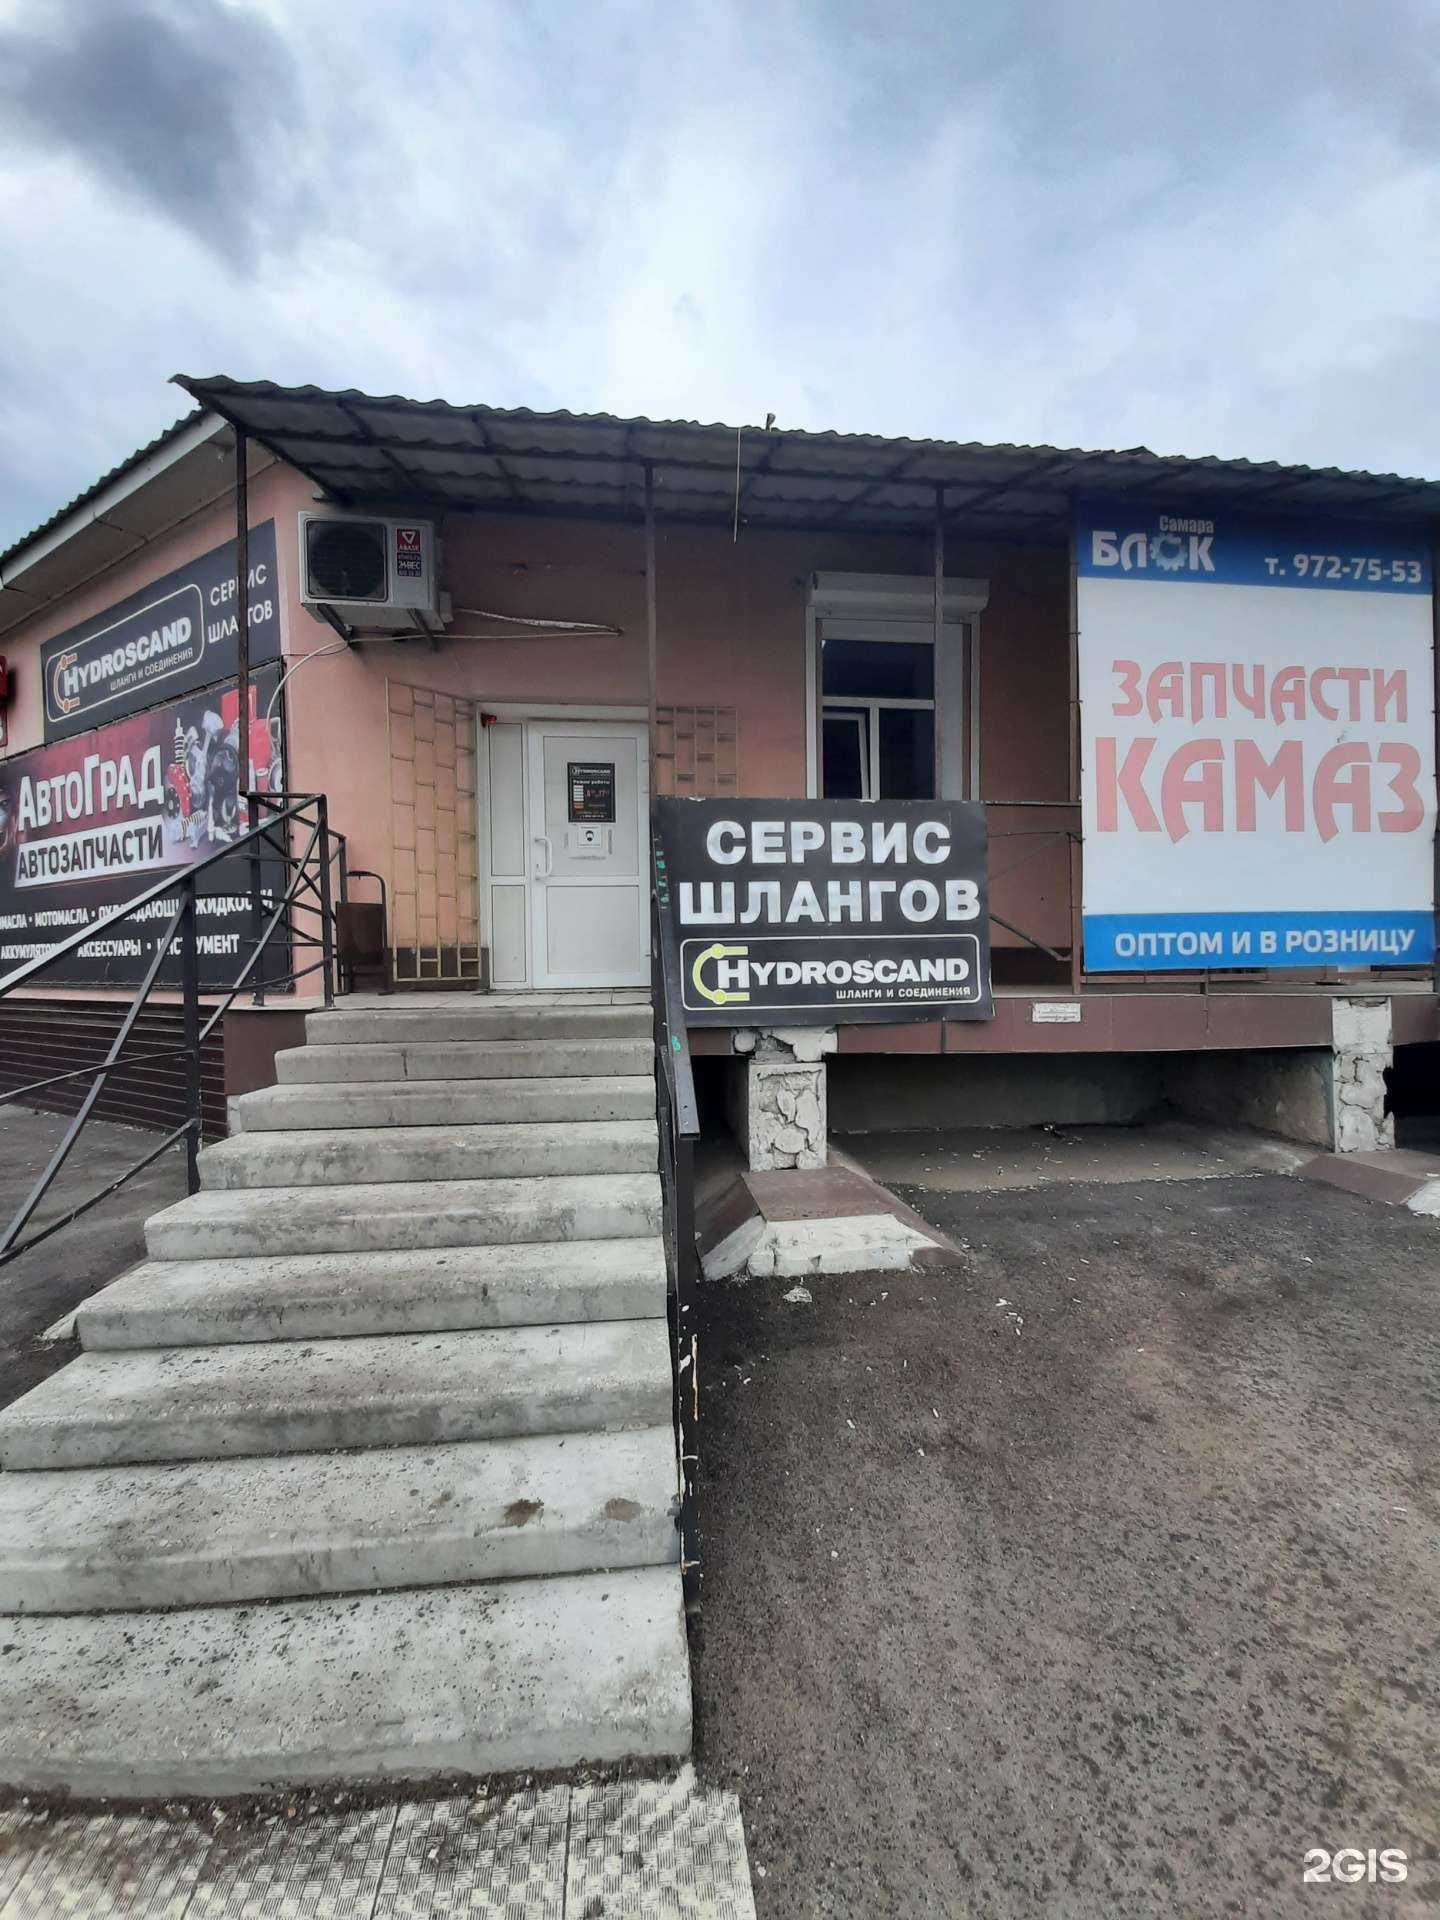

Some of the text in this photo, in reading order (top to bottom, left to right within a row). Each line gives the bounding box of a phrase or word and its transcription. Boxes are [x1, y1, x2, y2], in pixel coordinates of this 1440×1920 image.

[1158, 514, 1214, 534] Самара
[1091, 529, 1216, 572] БЛОК
[1264, 553, 1422, 584] т. 972-75-53
[210, 564, 267, 606] СЕРИС
[207, 599, 273, 644] ШЛАГОВ
[63, 616, 193, 697] HYDROSCAND
[144, 647, 194, 678] СОЕДИНЕНИЯ
[1111, 659, 1409, 726] ЗАПЧАСТИ
[1095, 736, 1426, 845] КАМАЗ
[17, 824, 164, 881] АВТОЗАПЧАСТИ
[706, 820, 952, 865] СЕРВИС
[35, 907, 89, 928] МОТОМАСЛА
[679, 878, 981, 925] ШЛАНГОВ
[77, 938, 141, 958] АКСЕССУАРЫ
[1115, 928, 1416, 957] ОПТОМ И В РОЗНИЦУ
[716, 957, 970, 989] HYDROSCAND
[836, 986, 971, 1000] ШЛАНГИ И СОЕДИНЕНИЯ
